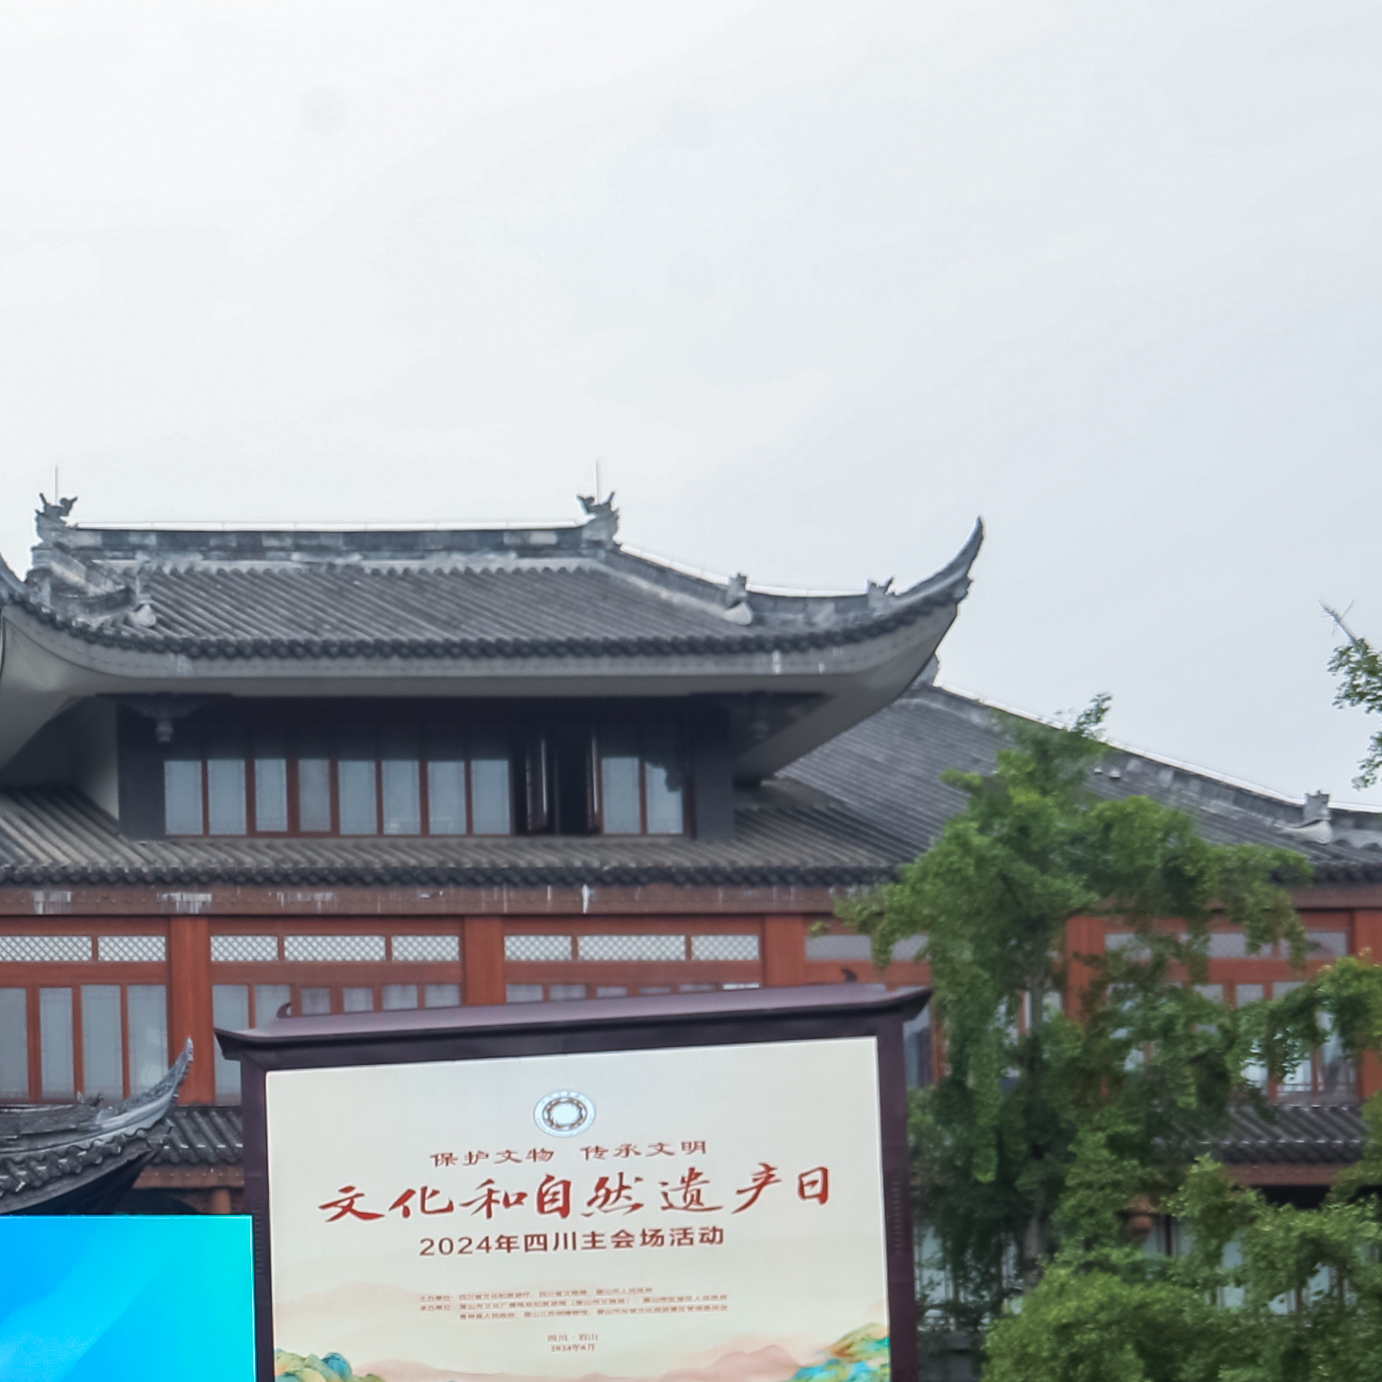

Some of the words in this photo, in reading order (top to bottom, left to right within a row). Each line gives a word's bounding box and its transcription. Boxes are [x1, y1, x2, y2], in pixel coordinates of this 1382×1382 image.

[430, 1148, 554, 1166] 保护文物
[580, 1141, 706, 1160] 传承文明
[318, 1163, 830, 1222] 文化和自然遗产日
[419, 1226, 725, 1256] 2024年四川主会场活动
